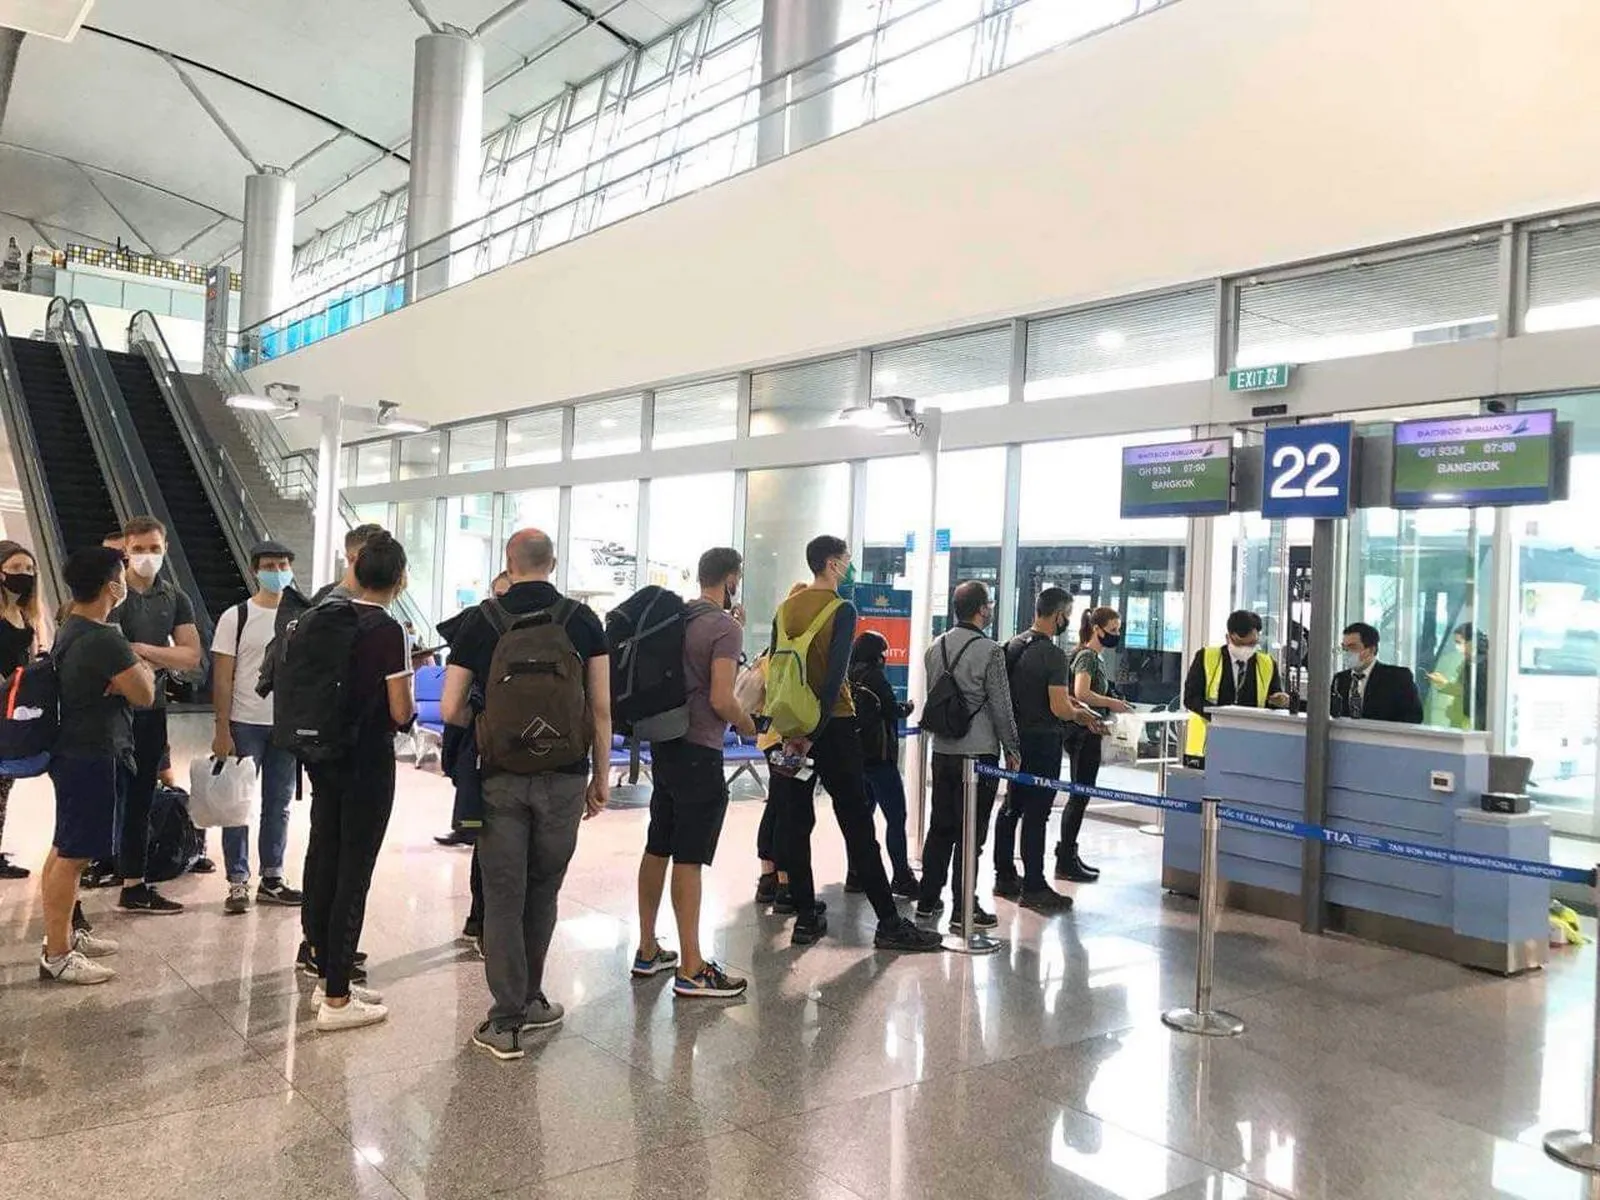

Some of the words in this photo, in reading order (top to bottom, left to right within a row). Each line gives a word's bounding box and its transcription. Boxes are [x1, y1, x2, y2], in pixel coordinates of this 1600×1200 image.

[1237, 370, 1264, 388] EXIT
[1465, 423, 1513, 434] AIRWAYS
[1271, 443, 1340, 498] 22
[1437, 460, 1500, 473] BANGKOK
[1151, 478, 1195, 489] BANGKOK
[889, 648, 907, 658] ITY
[1033, 776, 1051, 788] TIA
[1160, 799, 1188, 810] AIRPORT
[1322, 829, 1352, 844] TIA
[1449, 852, 1518, 871] INTERNATIONAL
[1520, 865, 1563, 878] AIRPORT
